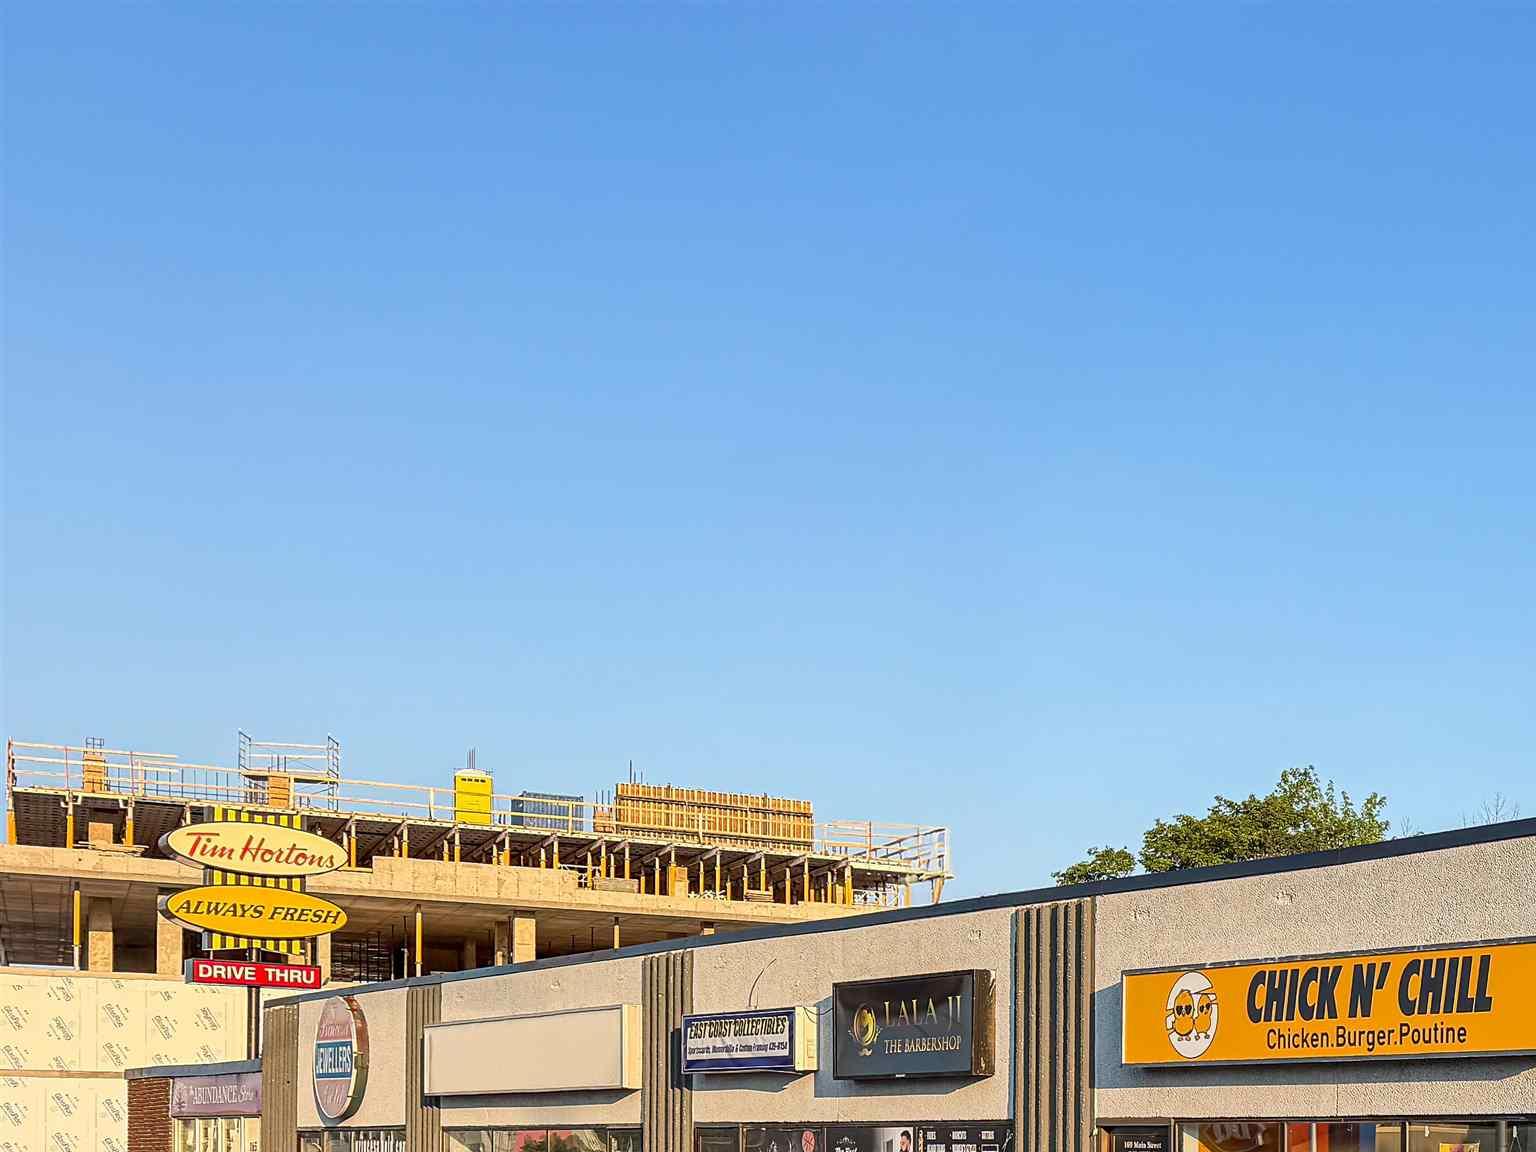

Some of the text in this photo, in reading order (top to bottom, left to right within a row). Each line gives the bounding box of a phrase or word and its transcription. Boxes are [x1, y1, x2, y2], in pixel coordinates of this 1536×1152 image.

[186, 832, 335, 869] Tim Hortons
[175, 899, 341, 925] ALWAYS FRESH
[198, 964, 315, 984] DRIVE THRU
[1246, 954, 1493, 1024] CHICK N' CHILL
[883, 998, 938, 1028] LALA
[688, 1016, 787, 1040] EAST COAST COLLECTIBLES
[884, 1035, 961, 1054] THE BARBERSHOP
[316, 1045, 352, 1074] JEWELLERS
[193, 1085, 237, 1105] ABUNDANCE
[1134, 1141, 1146, 1149] Main
[1147, 1141, 1161, 1149] Street
